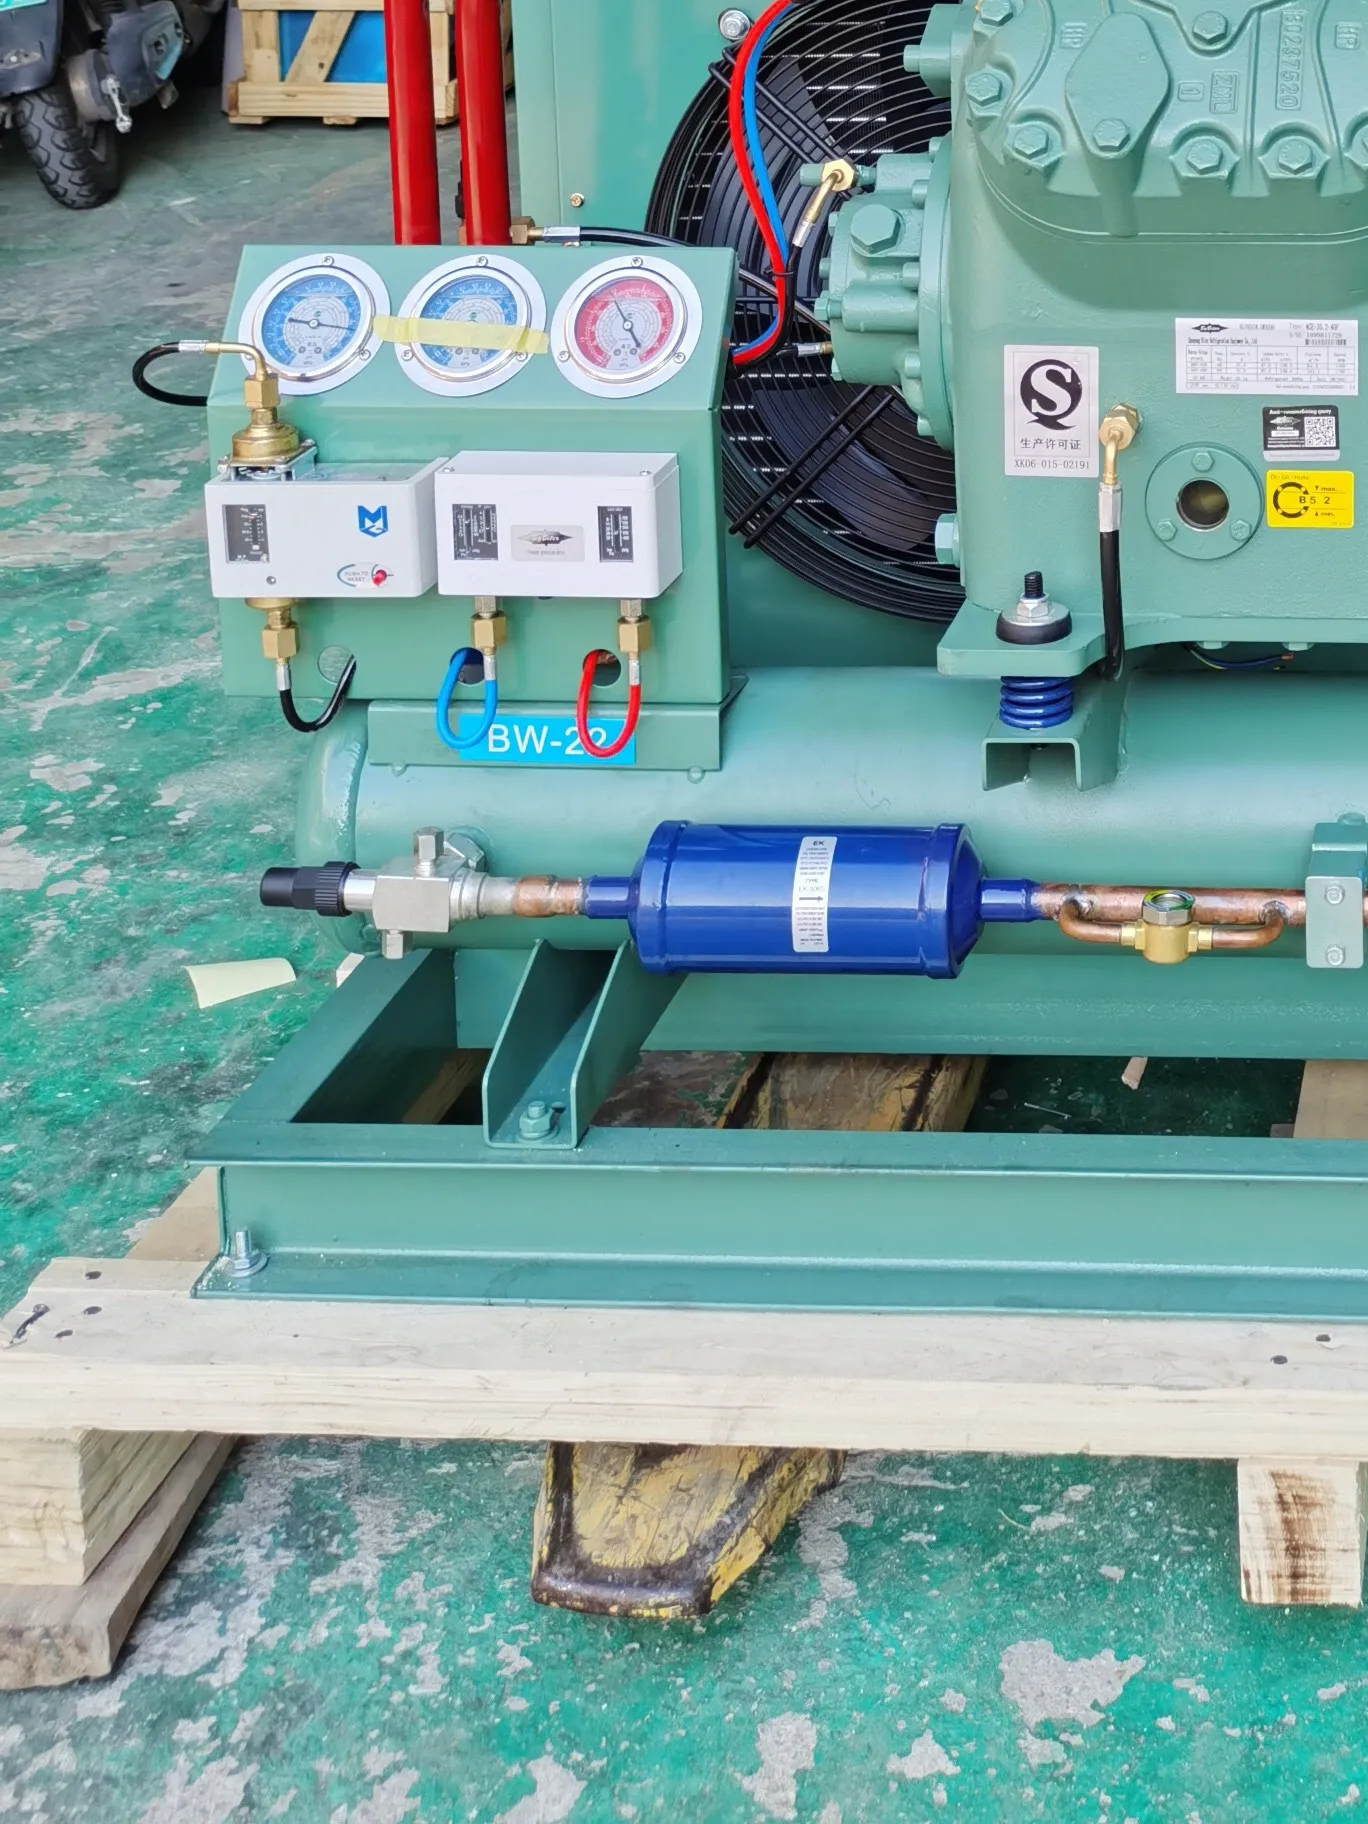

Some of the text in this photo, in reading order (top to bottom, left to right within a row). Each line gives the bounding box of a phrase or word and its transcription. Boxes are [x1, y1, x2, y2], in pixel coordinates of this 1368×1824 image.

[1020, 437, 1081, 450] 生产许可证
